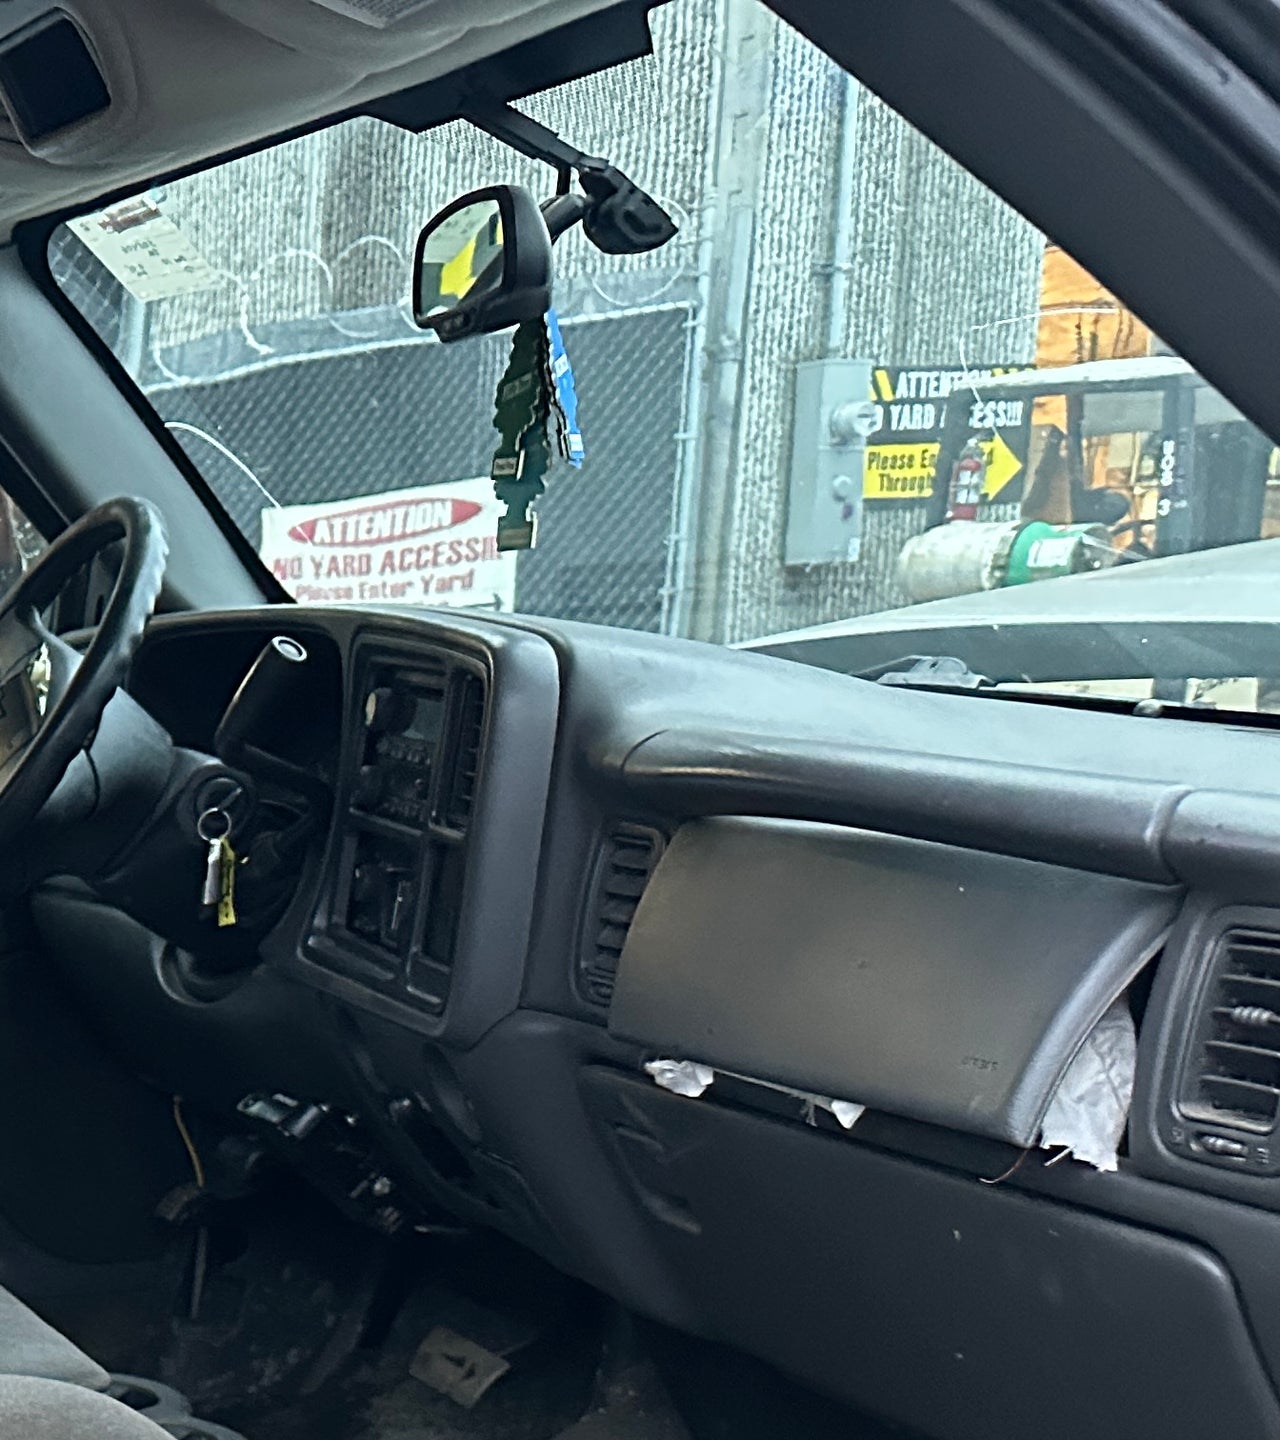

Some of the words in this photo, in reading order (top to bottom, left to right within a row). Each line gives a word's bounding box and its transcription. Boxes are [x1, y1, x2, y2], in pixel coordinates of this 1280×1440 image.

[890, 403, 935, 431] YARD
[939, 401, 1024, 428] ESS!!!
[867, 448, 915, 470] Please
[312, 499, 453, 544] ATTENTION
[274, 556, 303, 581] NO
[309, 553, 372, 579] YARD
[420, 568, 475, 597] Yard
